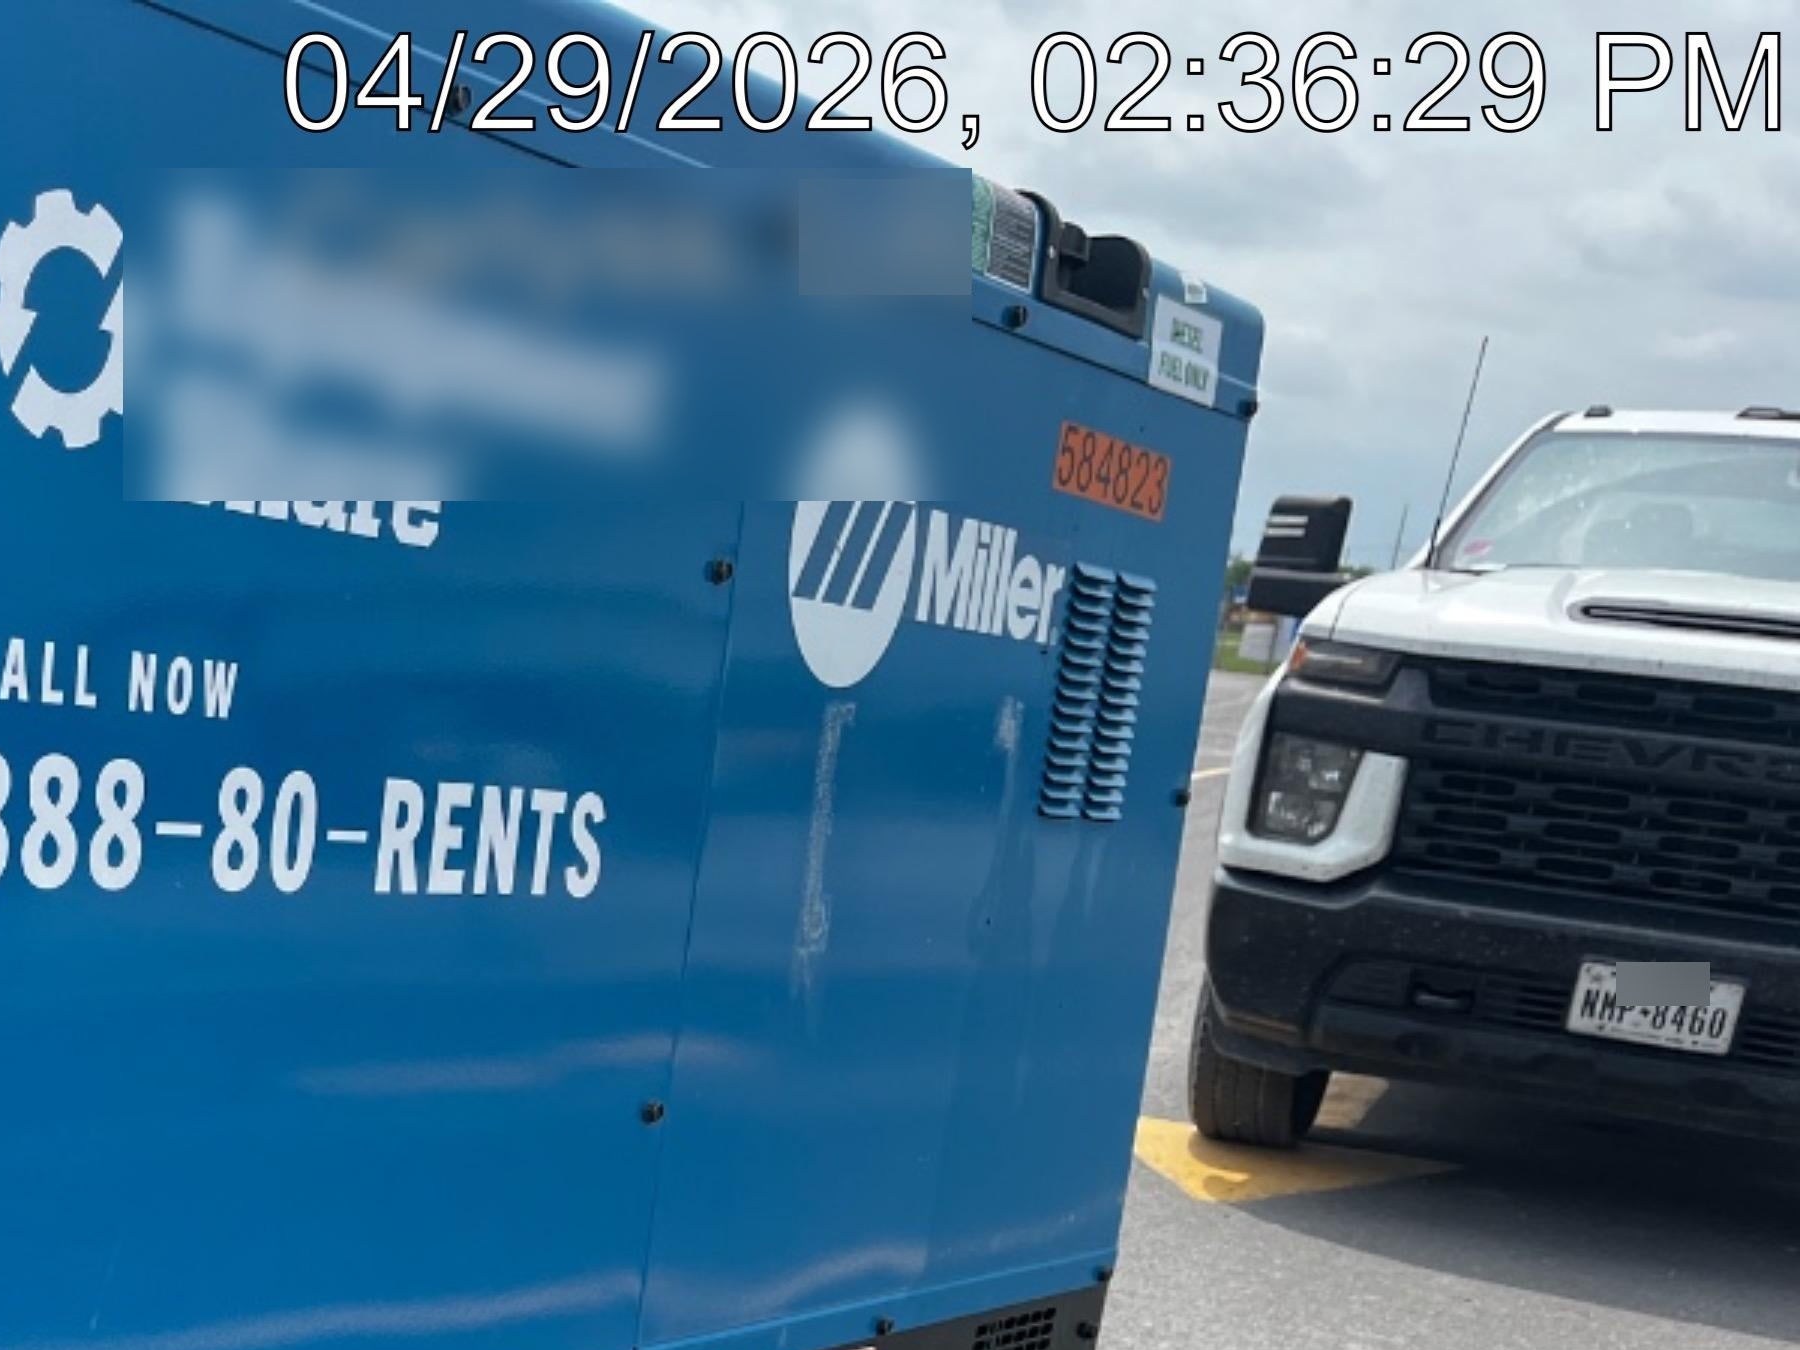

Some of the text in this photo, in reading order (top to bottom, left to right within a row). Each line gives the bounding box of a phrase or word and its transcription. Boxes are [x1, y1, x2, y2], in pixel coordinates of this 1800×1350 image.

[1058, 425, 1169, 516] 584823
[914, 508, 1066, 645] Miller
[128, 650, 239, 720] NOW
